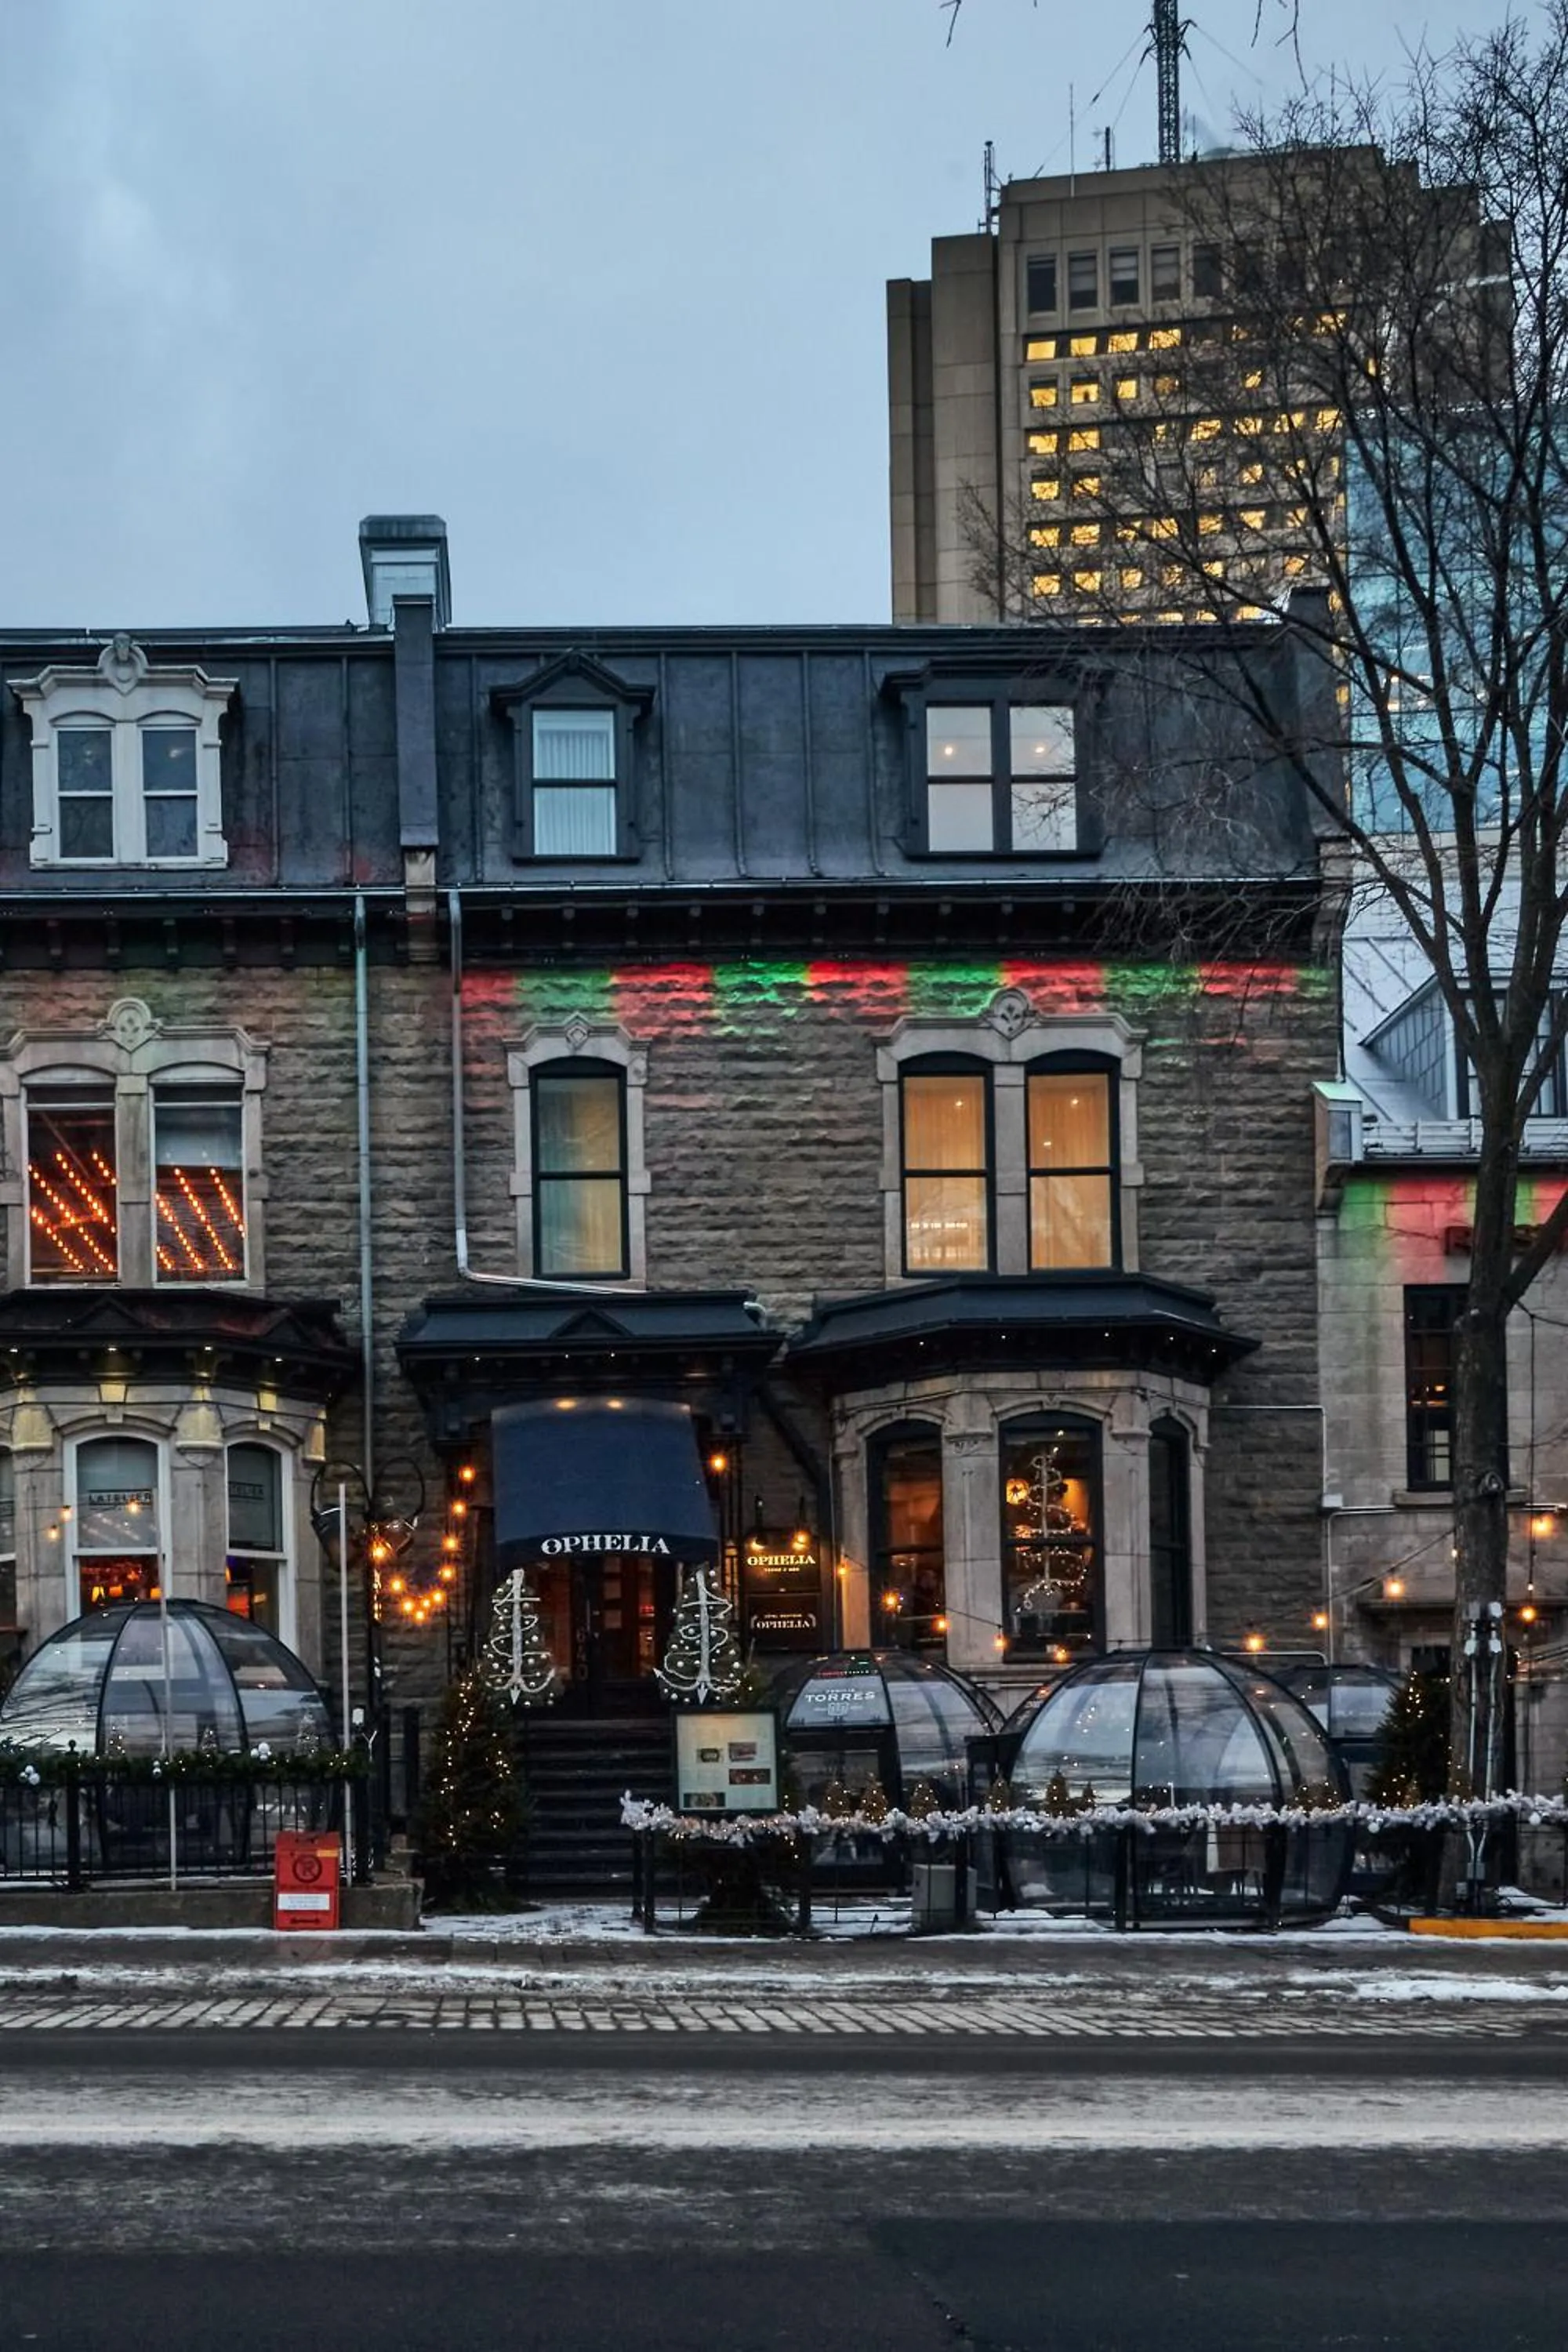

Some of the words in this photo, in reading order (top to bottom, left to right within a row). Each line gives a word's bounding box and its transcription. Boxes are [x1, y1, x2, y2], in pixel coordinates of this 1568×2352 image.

[541, 1534, 671, 1555] OPHELIA
[747, 1555, 816, 1566] OPHELIA
[757, 1620, 811, 1629] OPHELIA
[805, 1692, 876, 1703] TORRES
